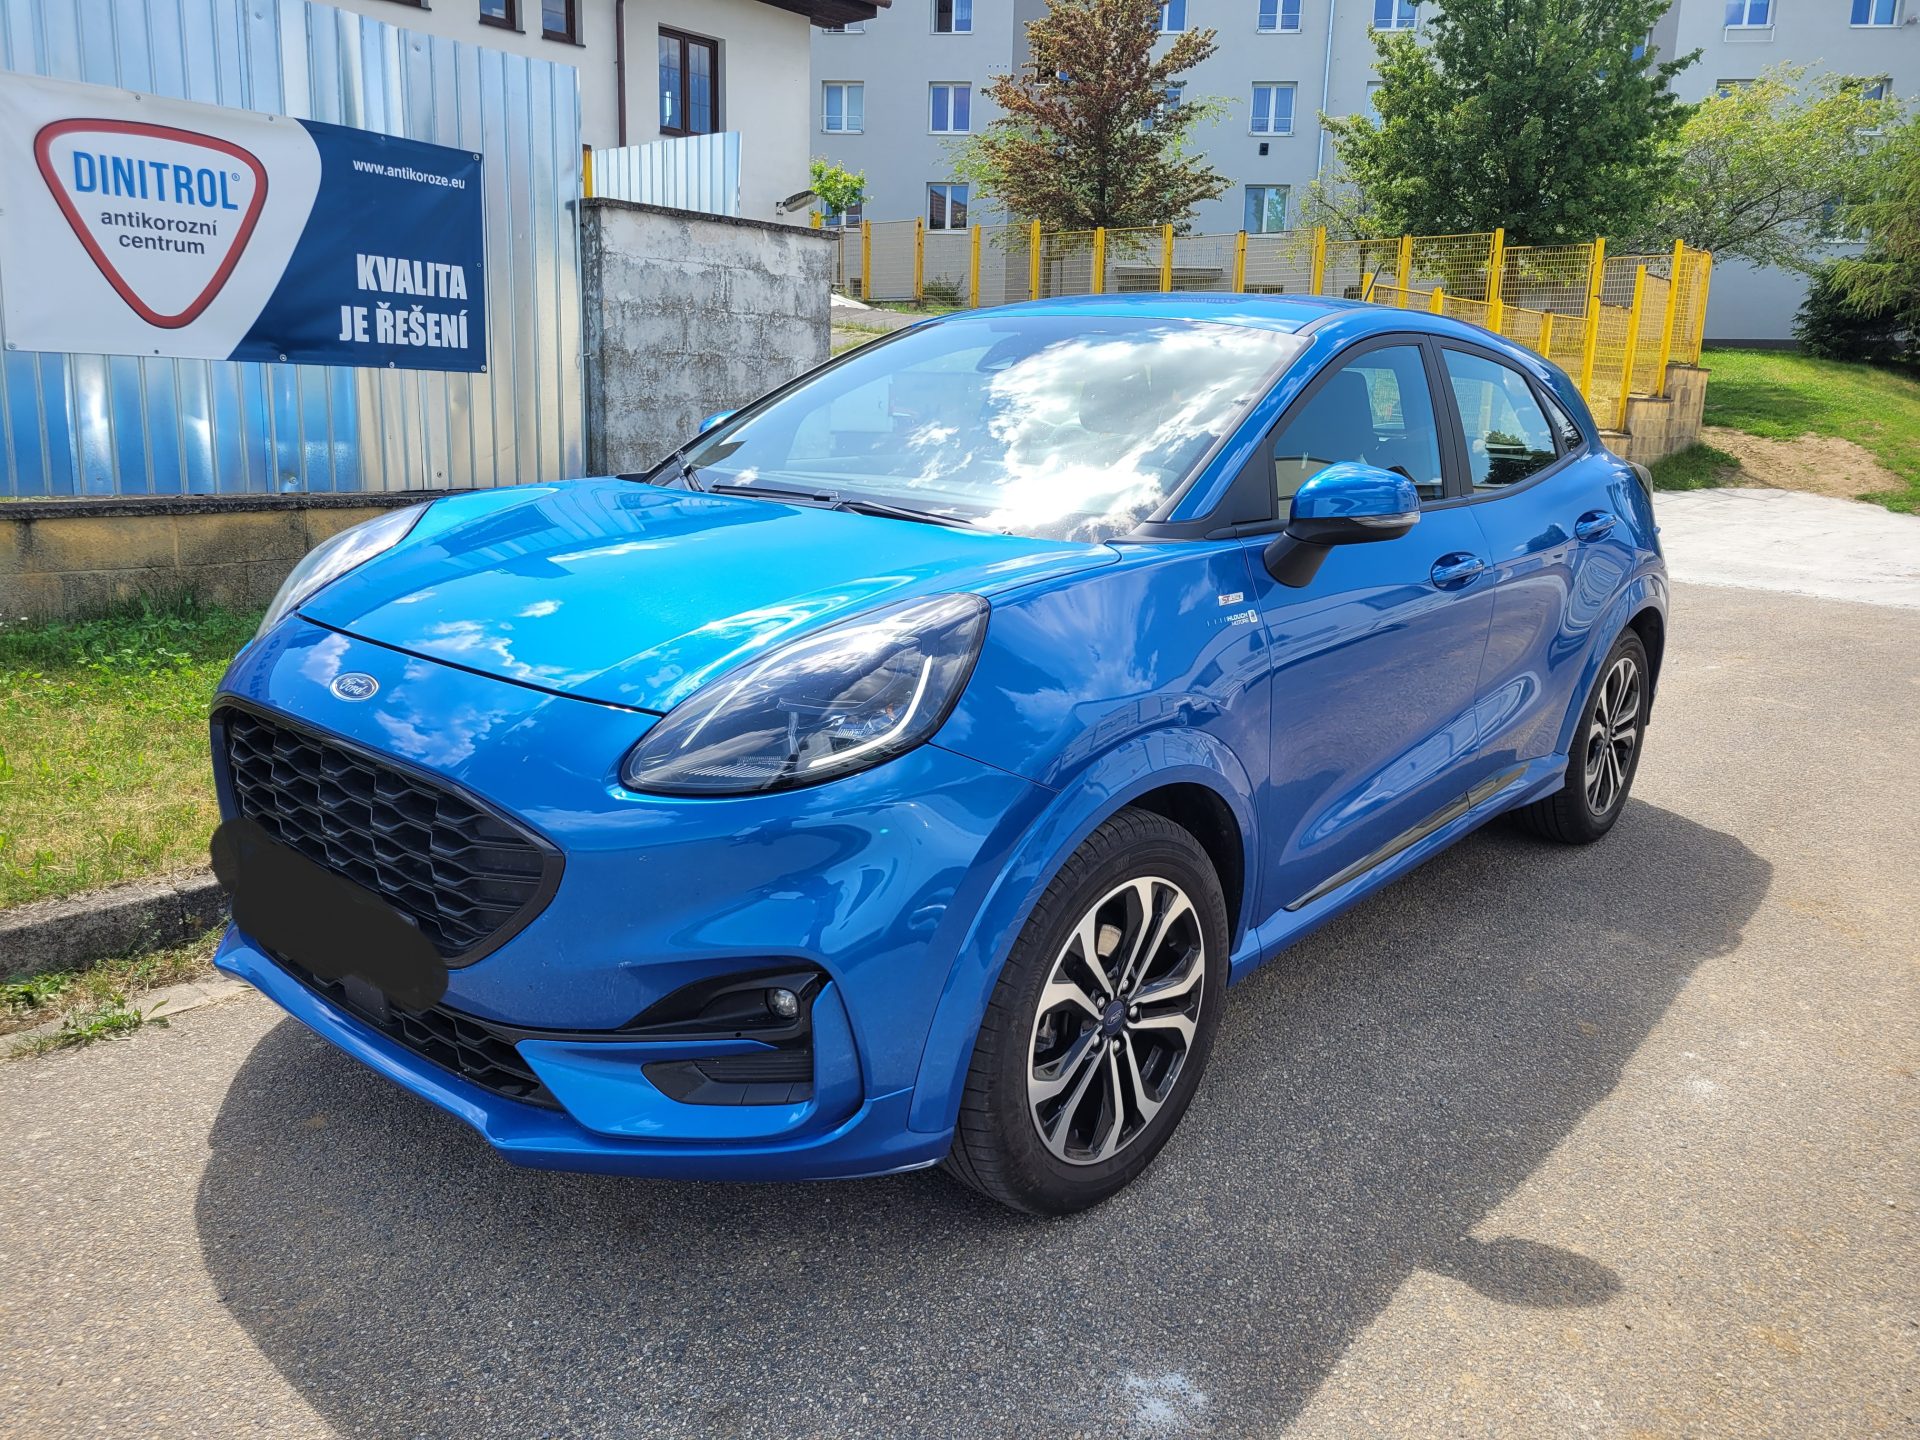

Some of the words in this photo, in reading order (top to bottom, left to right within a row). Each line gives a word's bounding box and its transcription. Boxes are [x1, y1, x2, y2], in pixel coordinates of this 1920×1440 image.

[352, 159, 466, 190] www.antikoroze.eu
[100, 211, 217, 237] antikorozní
[118, 233, 206, 255] centrum
[356, 253, 468, 300] KVALITA
[338, 304, 369, 342] JE
[375, 301, 469, 349] ŘEŠENÍ
[340, 678, 368, 695] Ford
